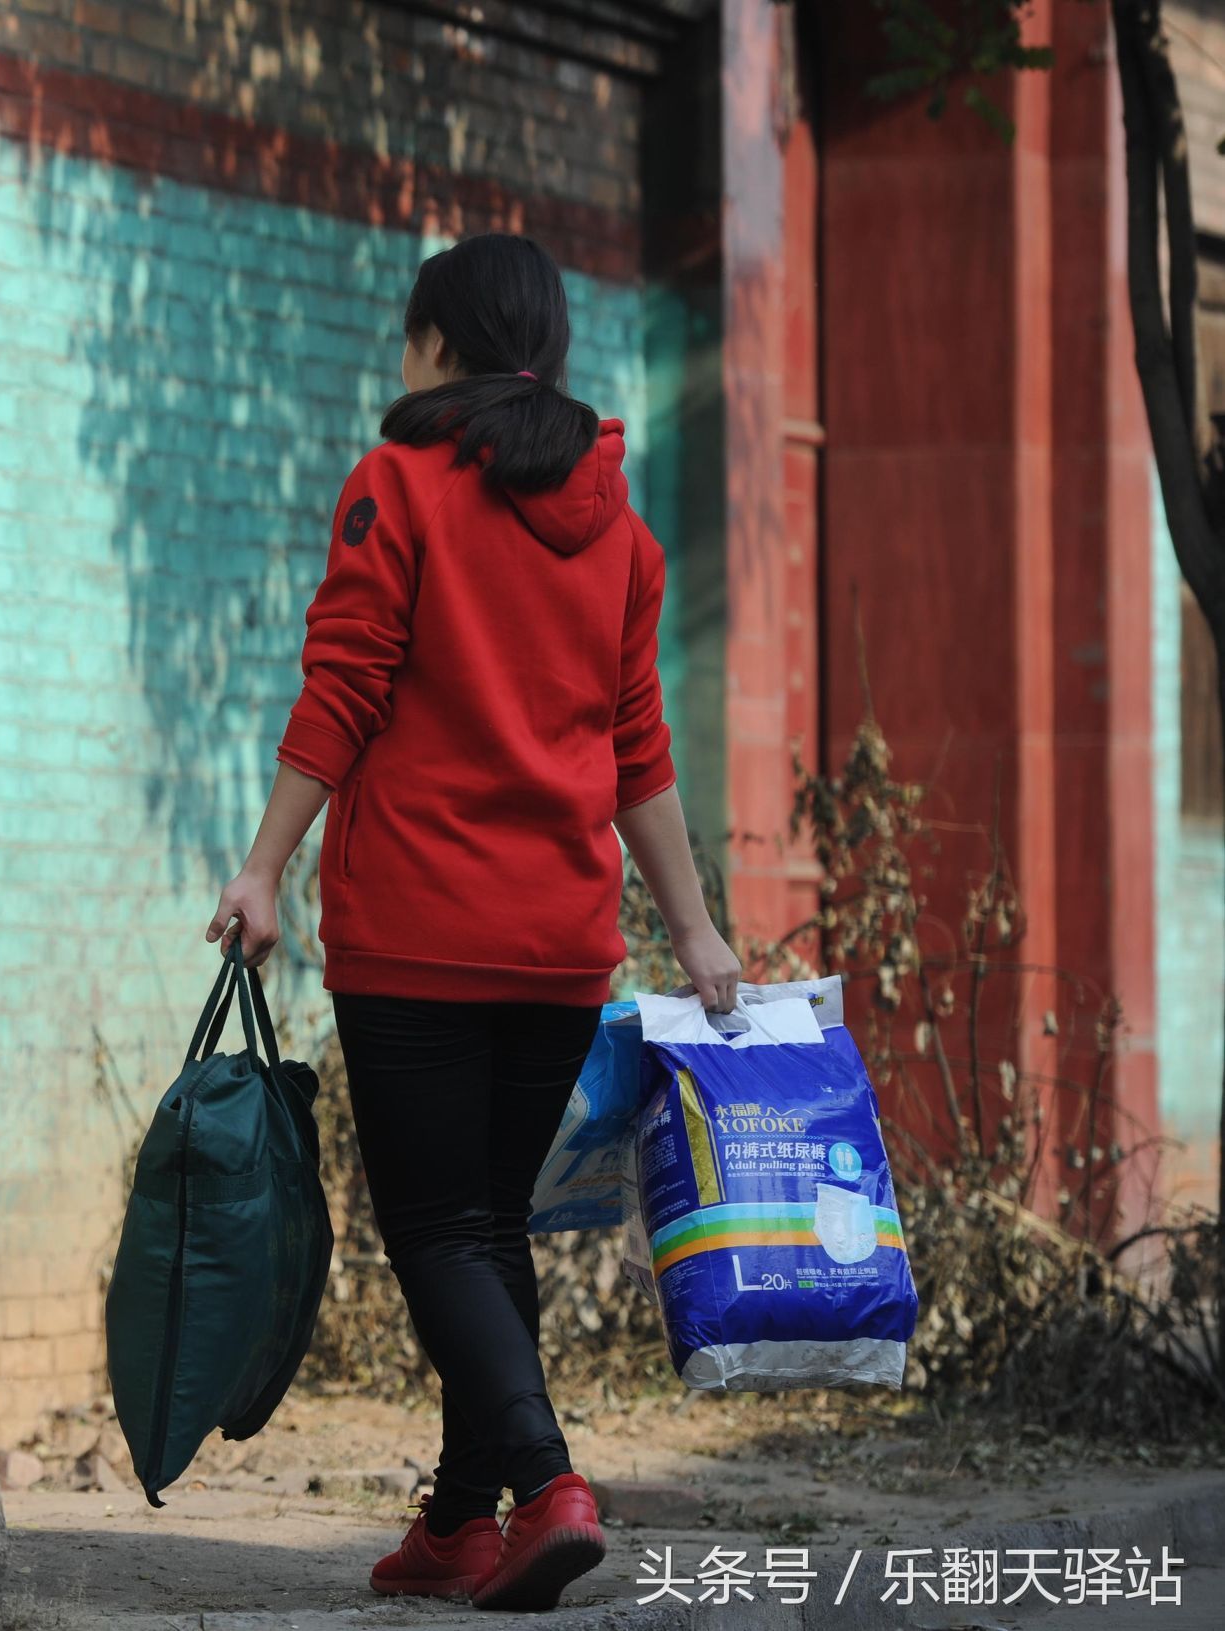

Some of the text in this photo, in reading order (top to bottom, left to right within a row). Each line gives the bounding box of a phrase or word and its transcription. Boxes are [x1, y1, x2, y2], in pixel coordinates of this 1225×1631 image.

[713, 1103, 762, 1118] 永福康
[716, 1117, 806, 1134] YOFOKE
[725, 1141, 826, 1160] 内裤式纸尿裤
[726, 1161, 825, 1172] Adult pulling pants
